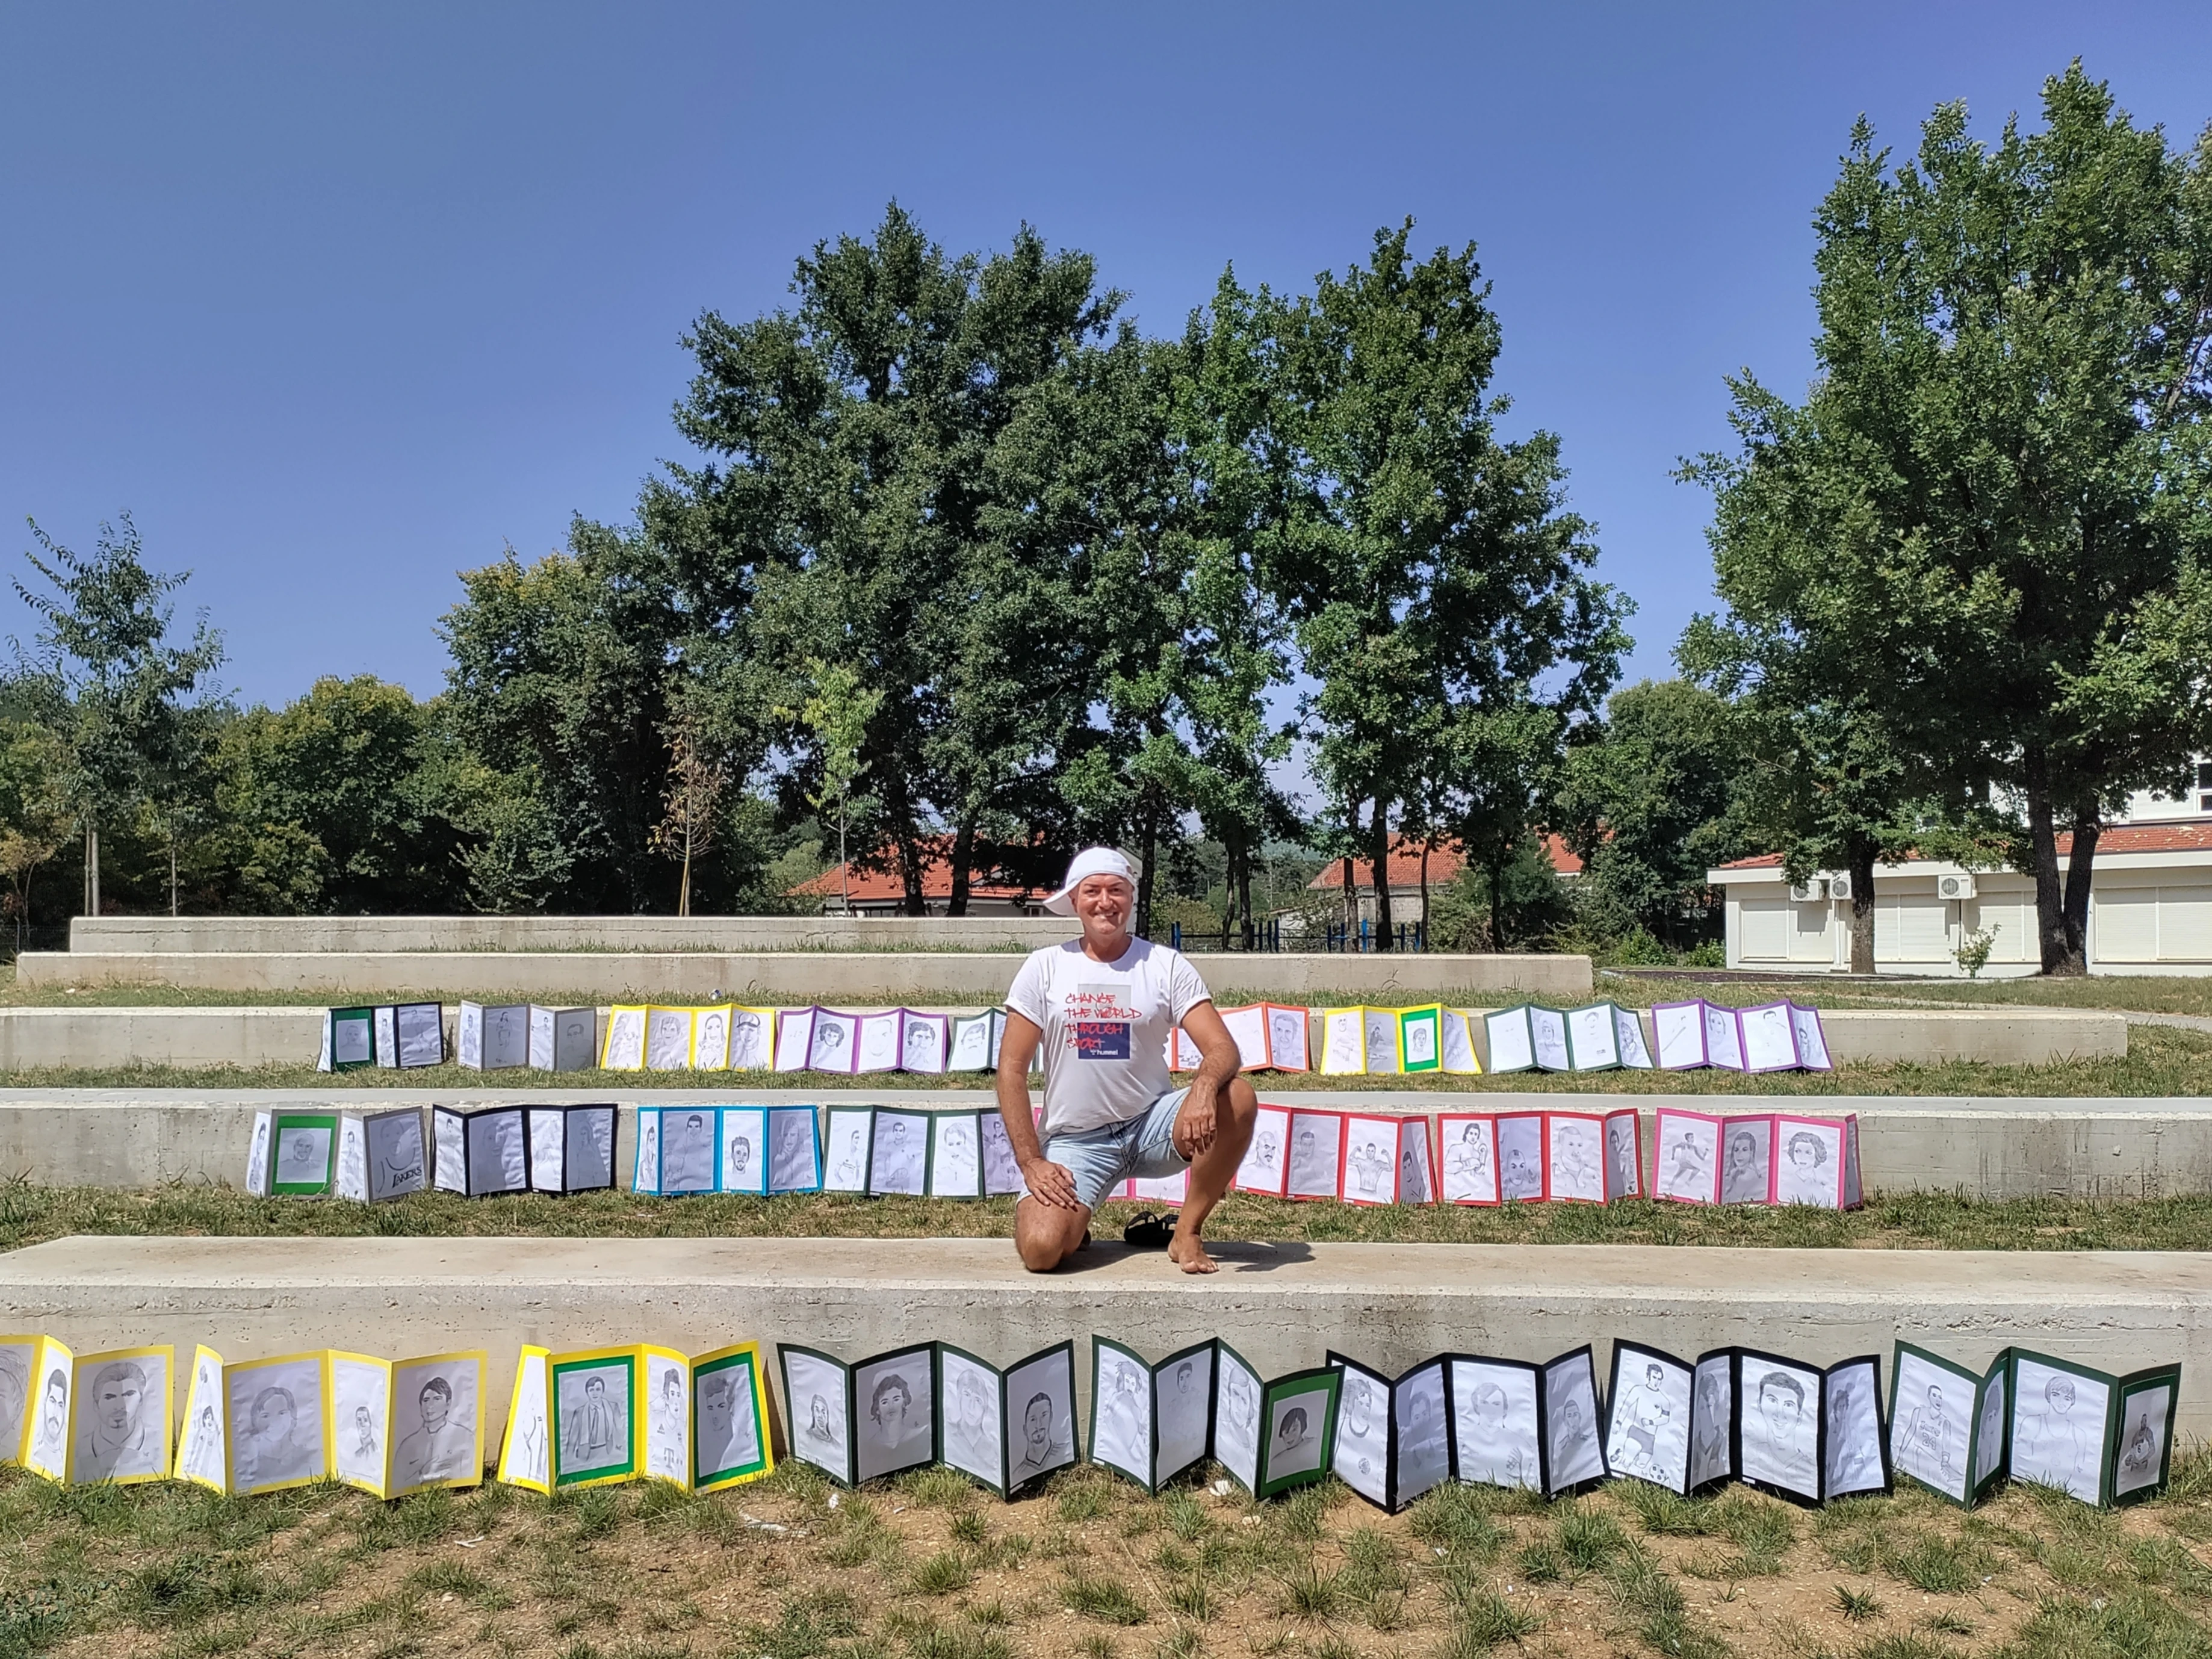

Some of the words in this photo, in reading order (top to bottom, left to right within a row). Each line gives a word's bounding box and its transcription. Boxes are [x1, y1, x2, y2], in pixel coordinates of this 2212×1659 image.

[1065, 993, 1117, 1004] CHANGE
[1064, 1007, 1092, 1019] THE
[1094, 1007, 1142, 1019] WORLD
[1064, 1022, 1124, 1035] THROUGH
[1066, 1037, 1106, 1050] SPORT
[1922, 1432, 1936, 1451] 24
